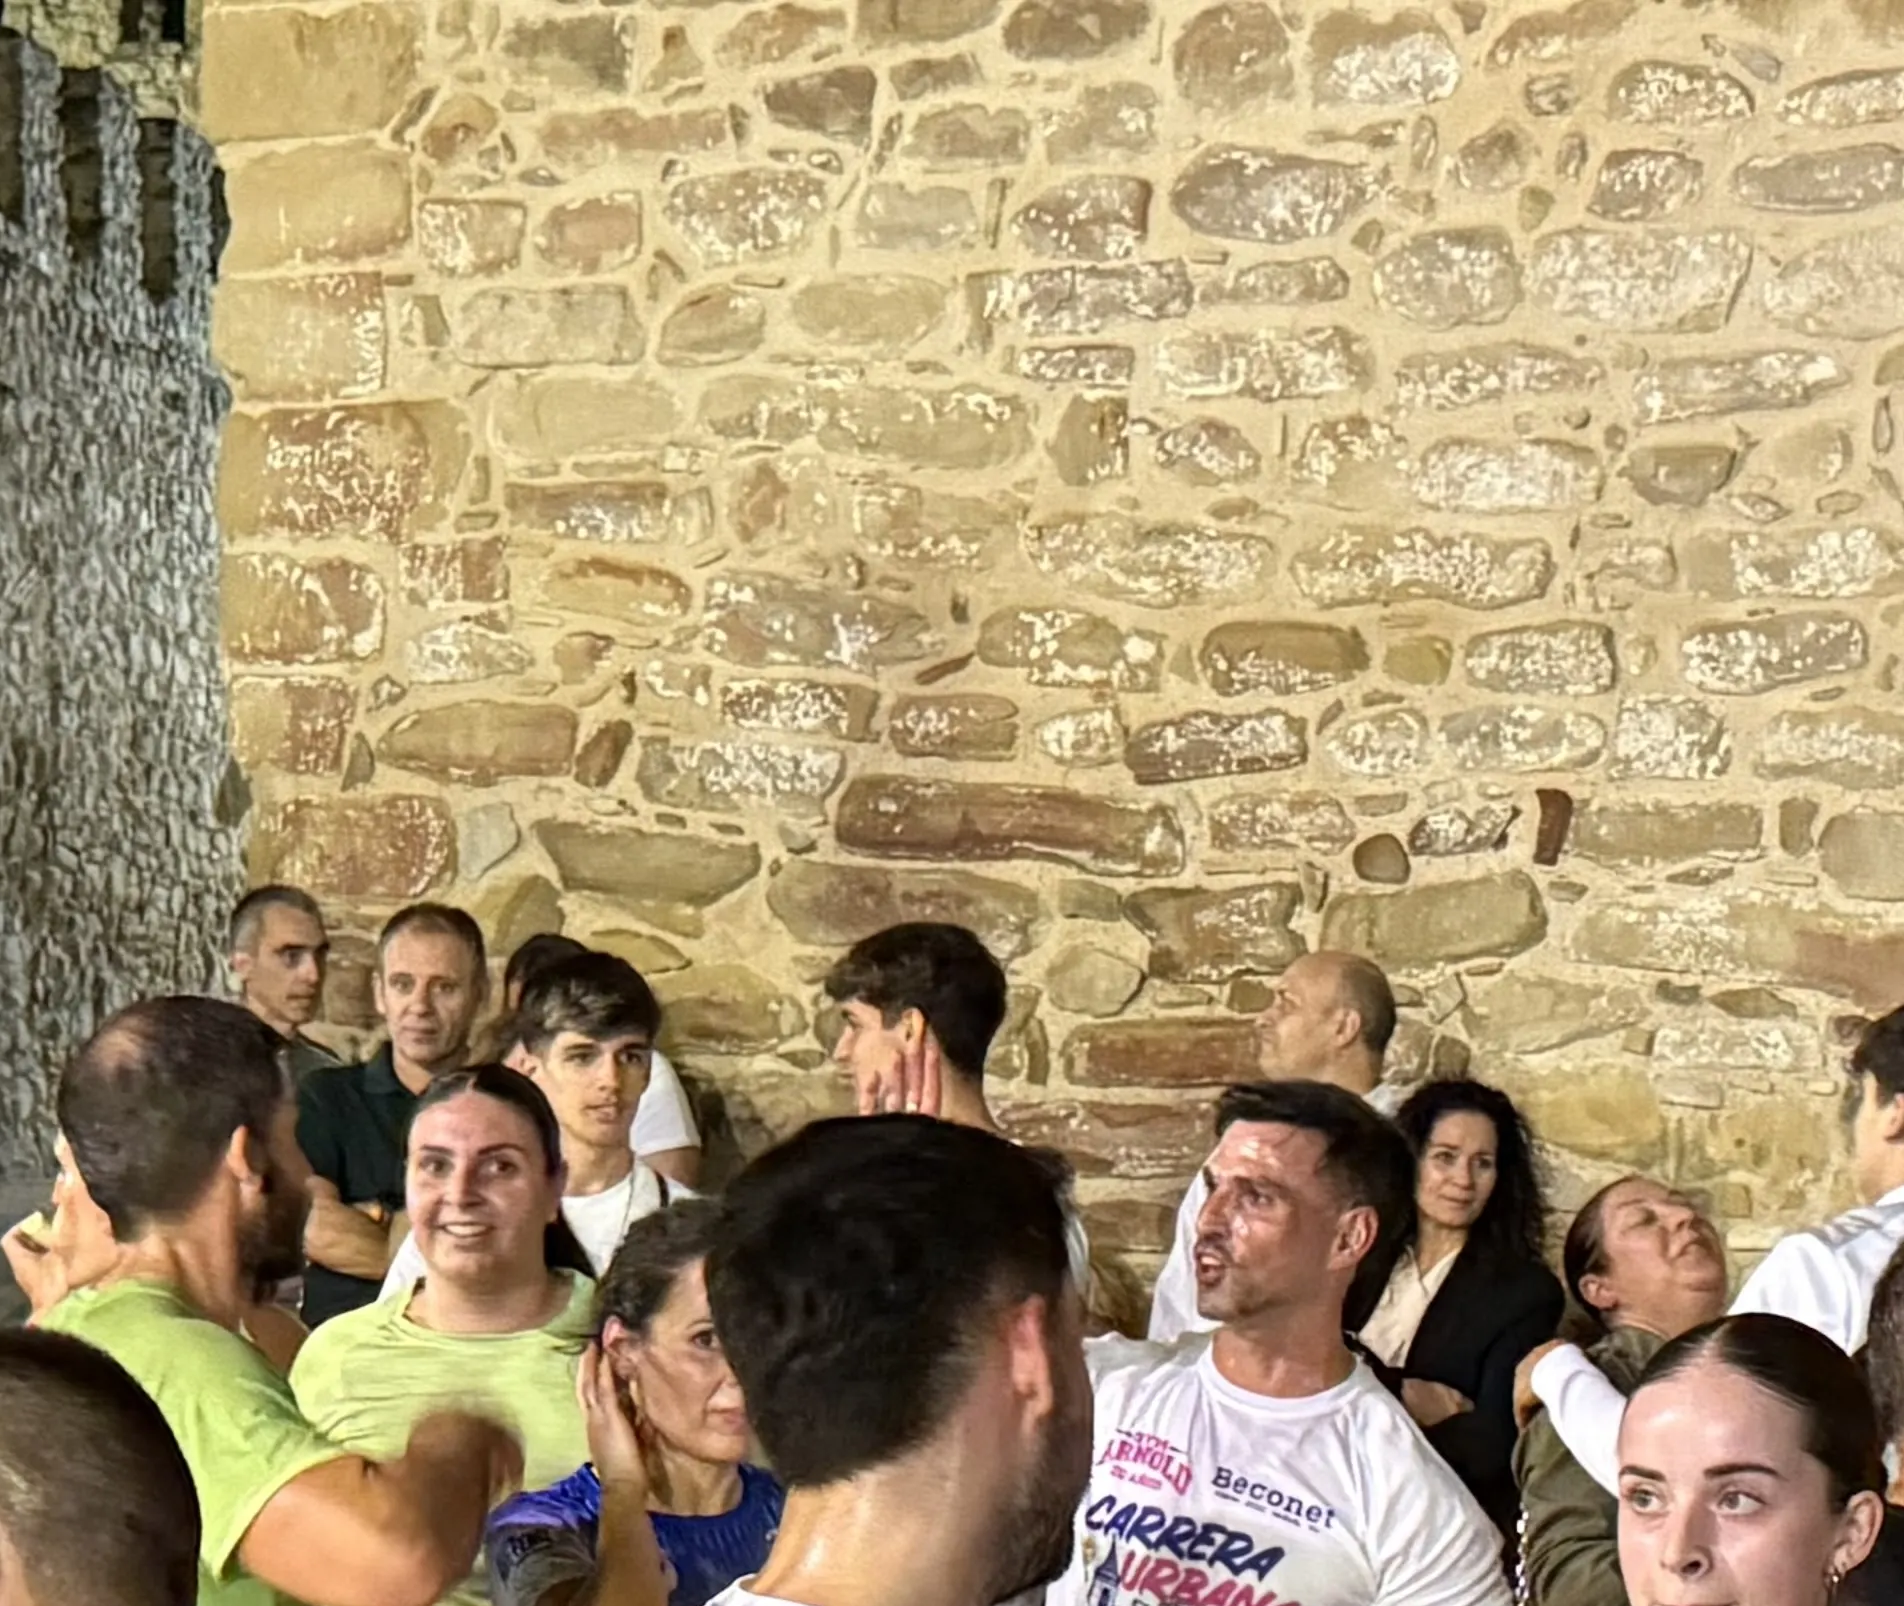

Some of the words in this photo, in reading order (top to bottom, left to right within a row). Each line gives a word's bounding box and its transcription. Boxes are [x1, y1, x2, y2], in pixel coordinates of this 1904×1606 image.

[1095, 1439, 1193, 1496] ARNOLD
[1211, 1466, 1336, 1529] Beconet
[1085, 1494, 1286, 1582] CARRERA
